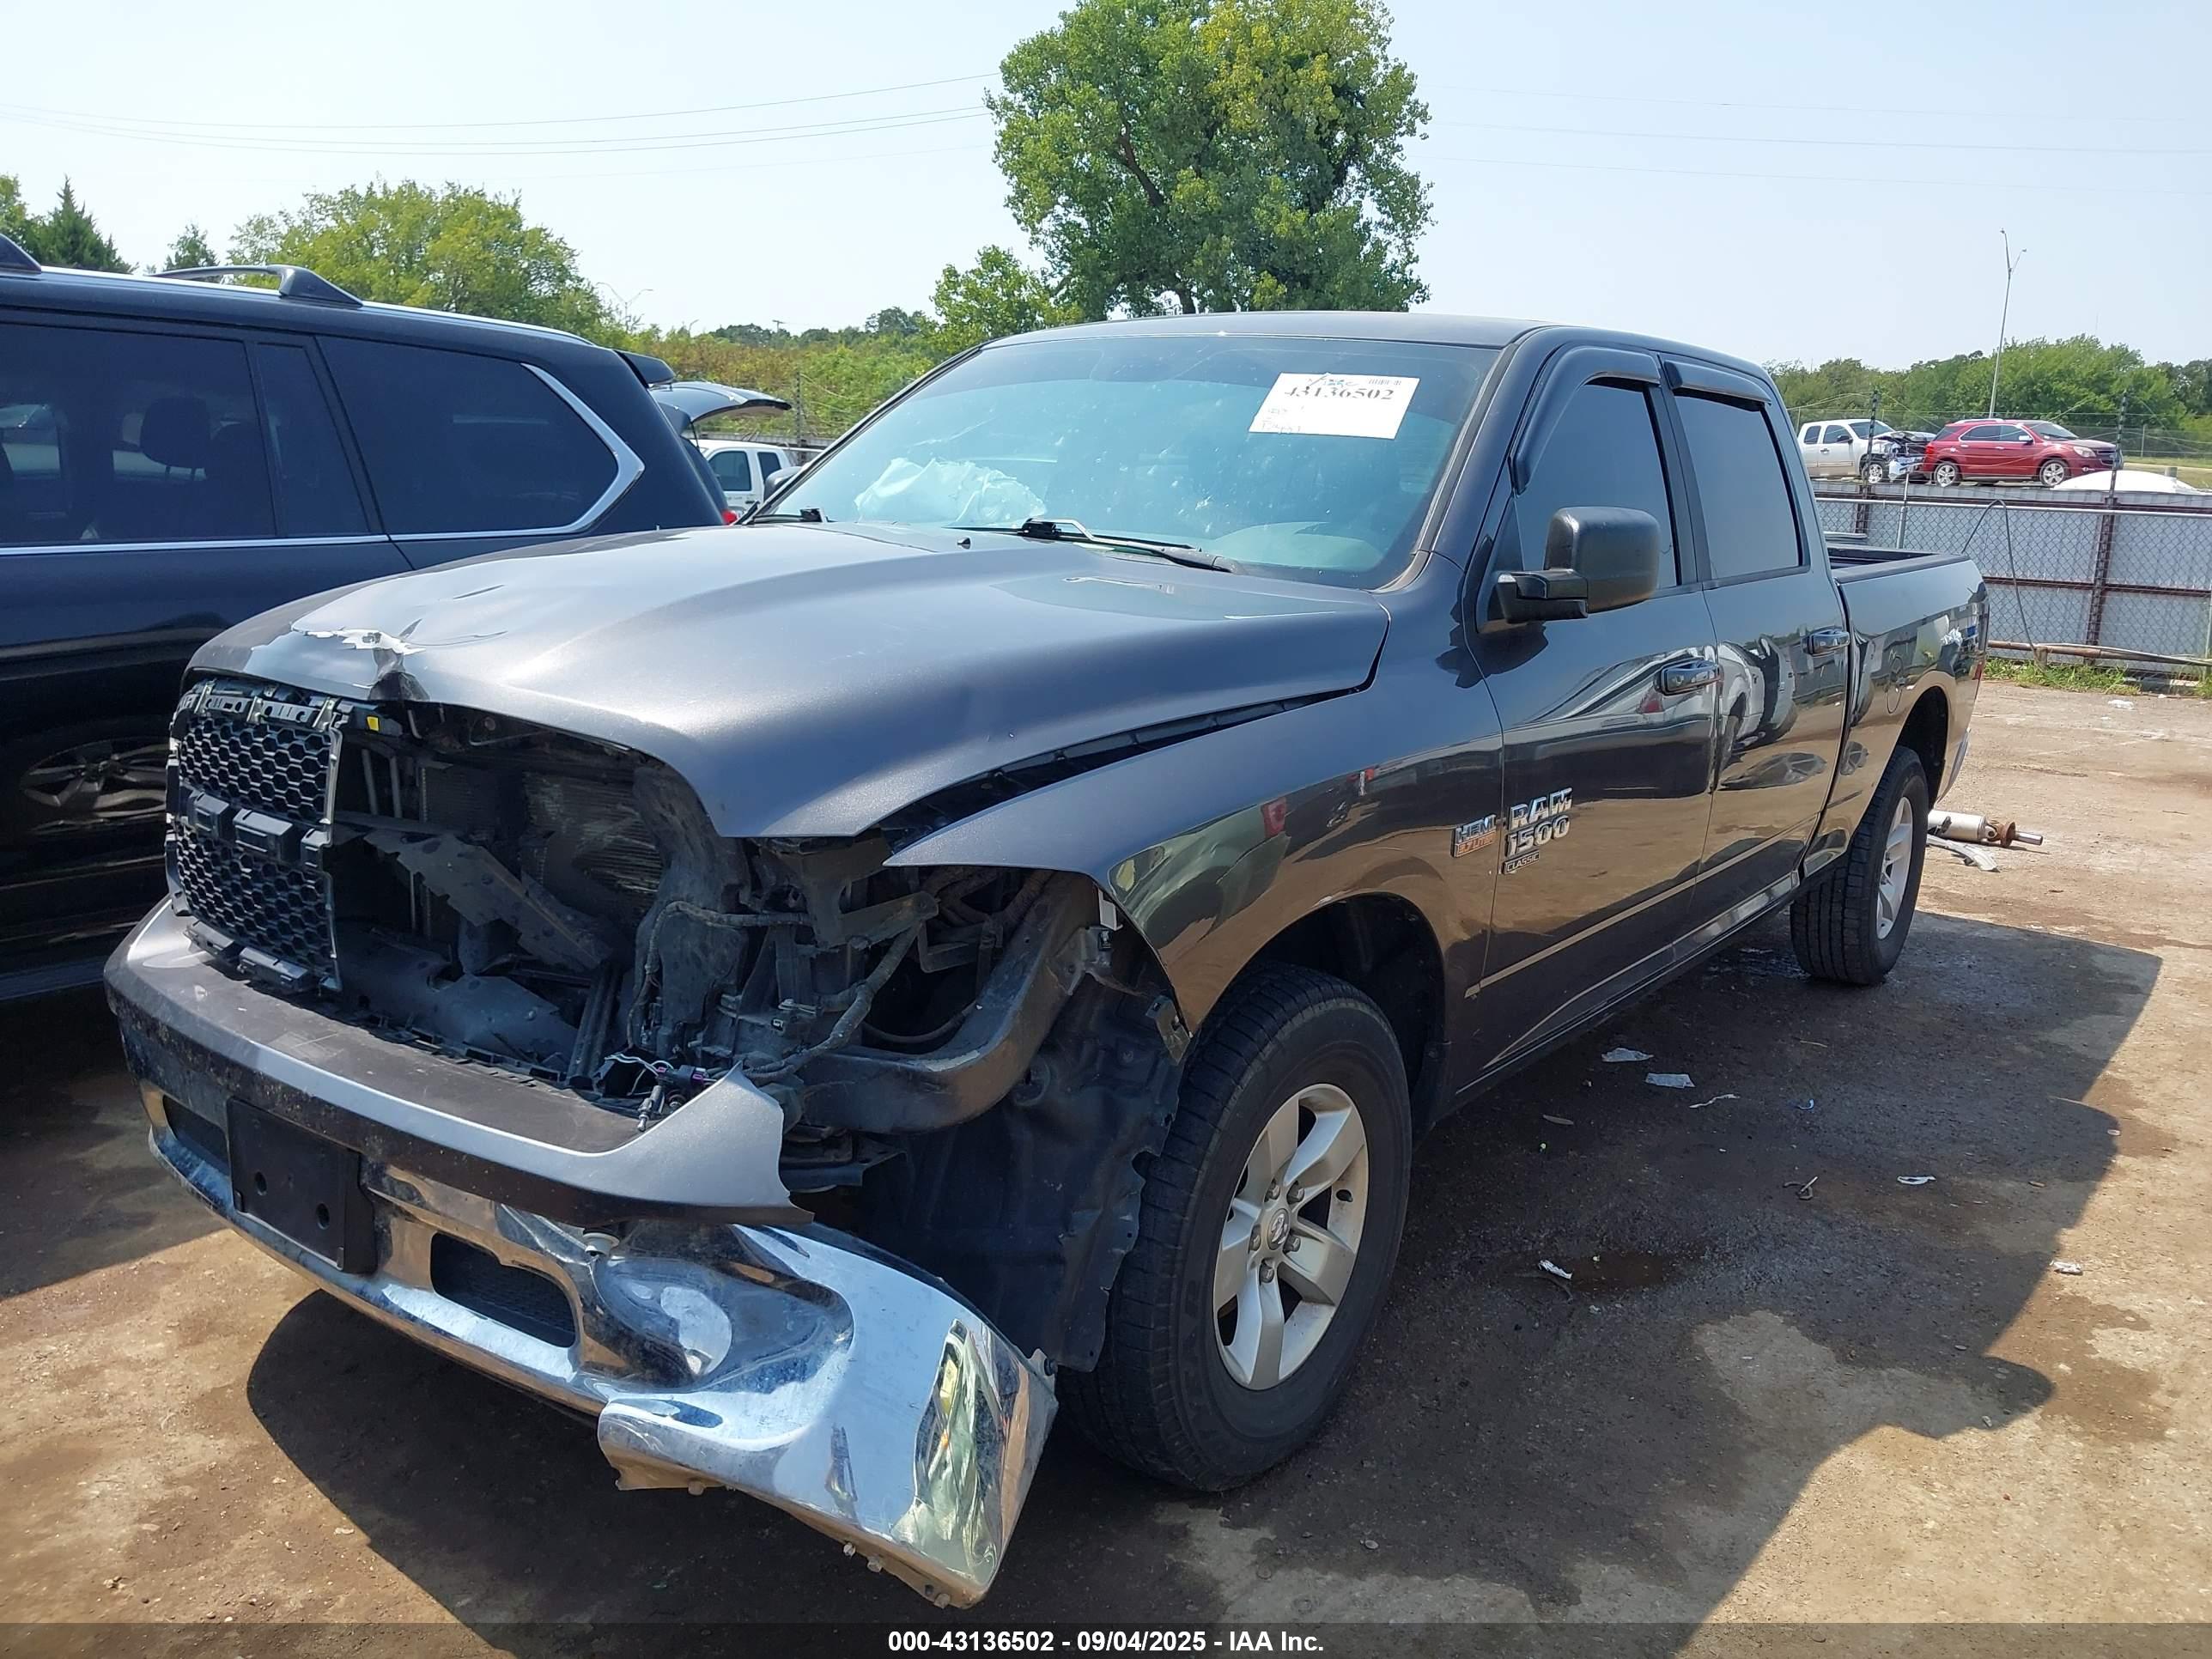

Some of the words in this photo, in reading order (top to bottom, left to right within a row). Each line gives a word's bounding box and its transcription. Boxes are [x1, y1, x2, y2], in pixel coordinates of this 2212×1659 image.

[1510, 787, 1572, 830] RAM
[1455, 813, 1496, 842] HEMI
[1508, 814, 1571, 857] 1500
[1507, 853, 1539, 872] CLASSIC
